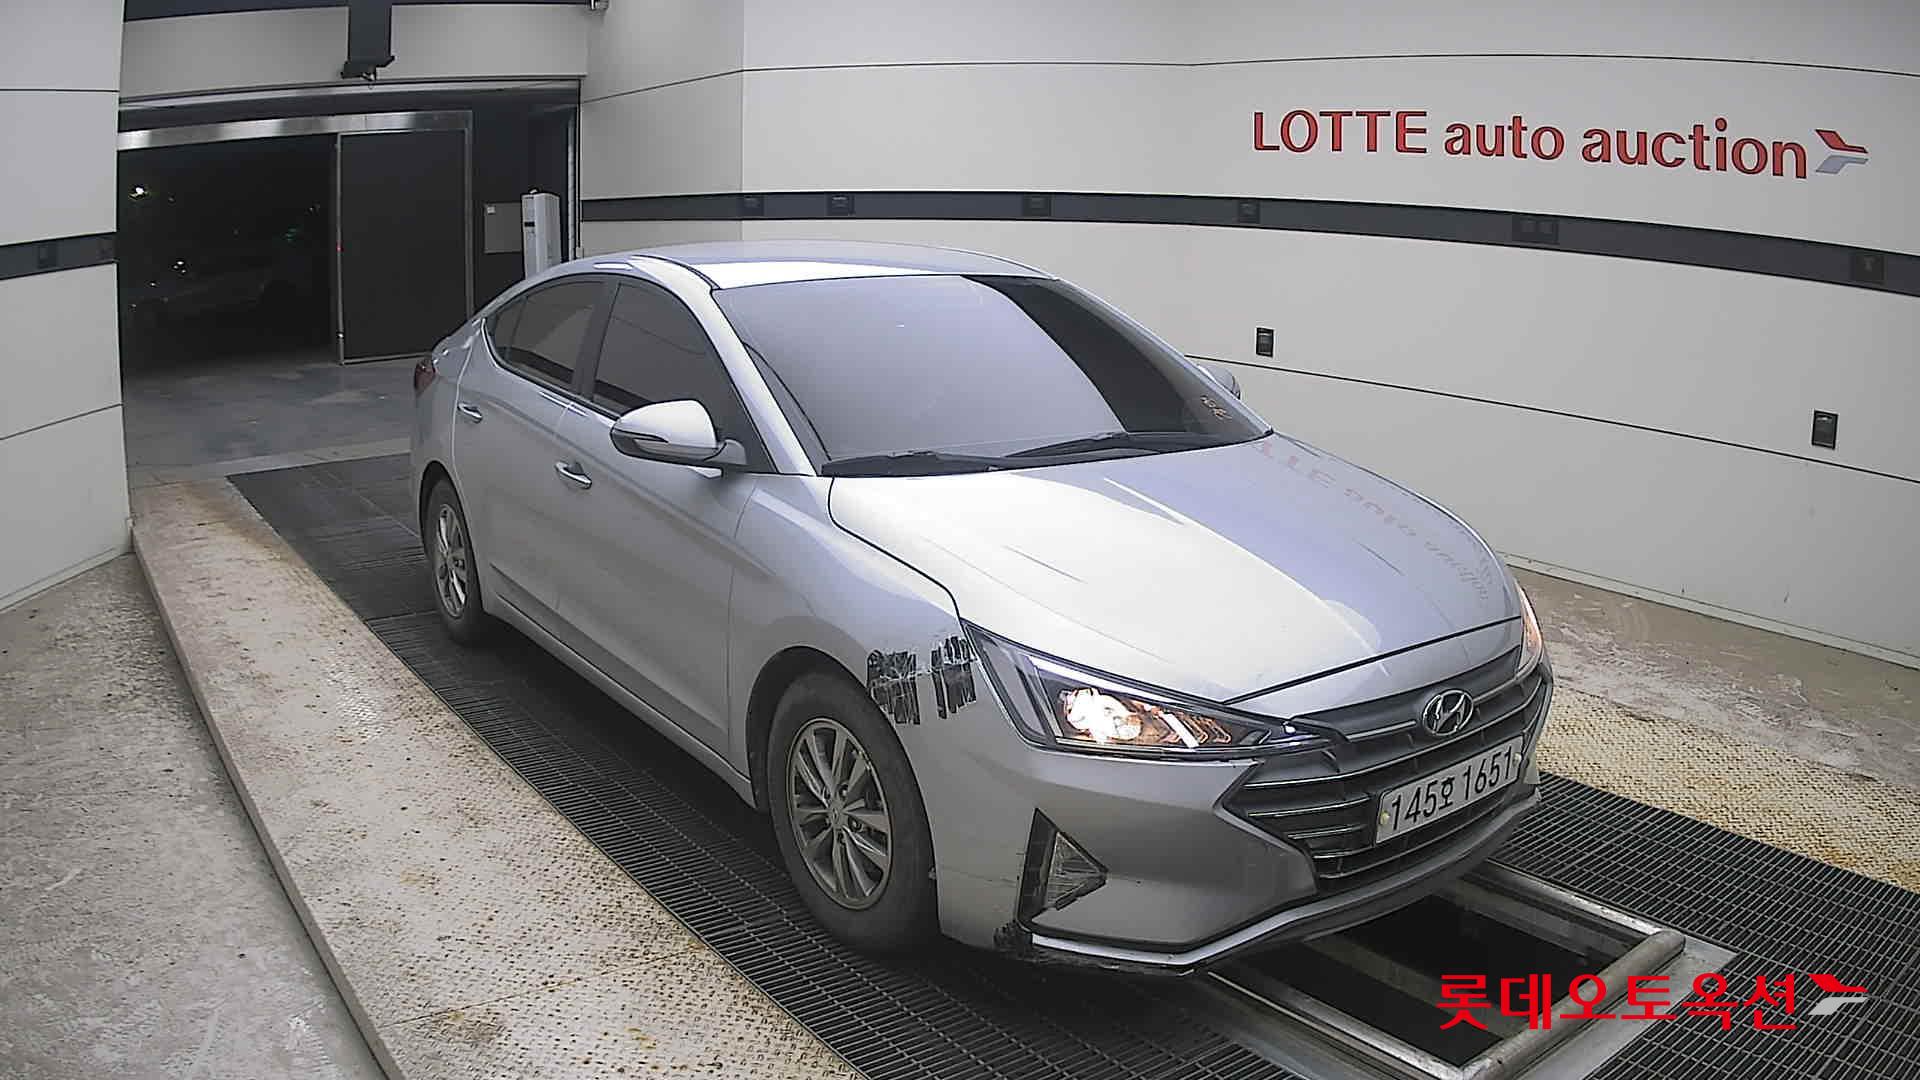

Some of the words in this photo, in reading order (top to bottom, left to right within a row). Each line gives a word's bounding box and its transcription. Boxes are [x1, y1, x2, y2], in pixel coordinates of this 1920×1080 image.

[1253, 110, 1428, 154] LOTTE
[1444, 116, 1565, 161] auto
[1581, 118, 1807, 179] auction
[1391, 776, 1456, 831] 145호
[1463, 745, 1513, 801] 1651
